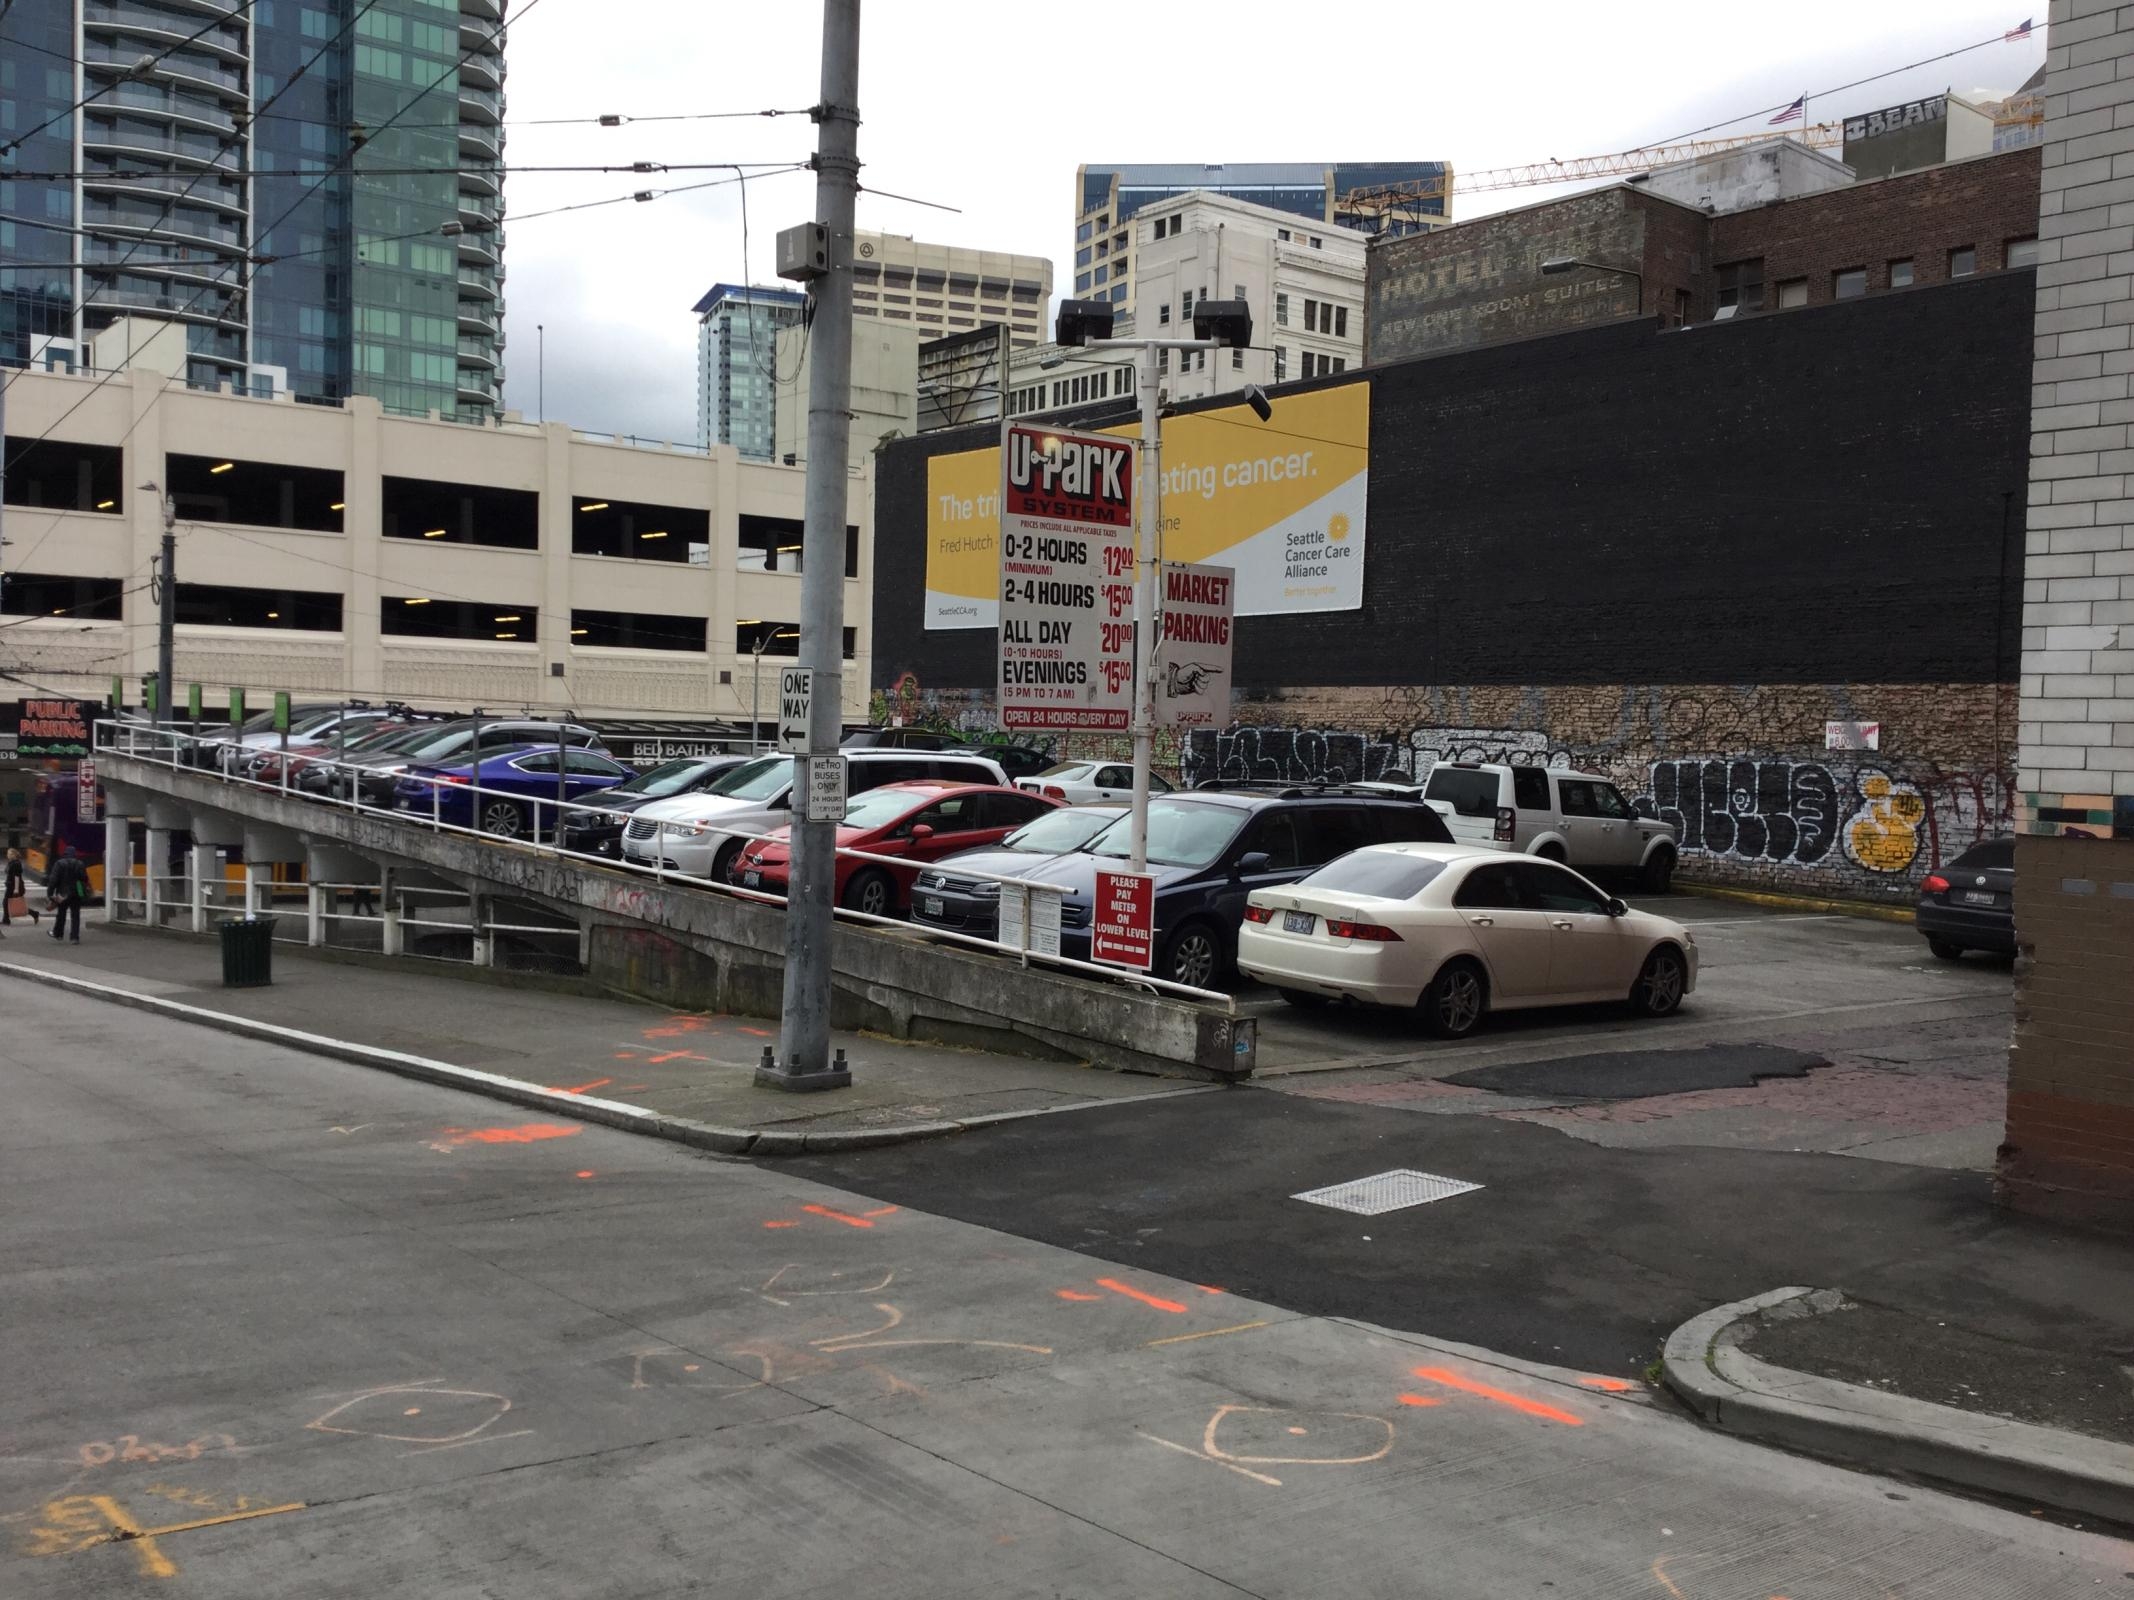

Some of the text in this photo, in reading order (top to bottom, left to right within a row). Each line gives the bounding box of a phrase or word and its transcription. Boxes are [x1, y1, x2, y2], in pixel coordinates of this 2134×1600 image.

[1544, 275, 1622, 303] SUITES
[939, 494, 973, 521] The
[1223, 451, 1317, 488] cancer.
[1023, 498, 1115, 521] SYSTEM
[1020, 520, 1117, 537] PRICES INCLUDE ALL APPLICABLE TAXES
[940, 535, 960, 553] Fred
[963, 534, 993, 551] Hutch
[1286, 530, 1325, 546] Seattle
[1005, 534, 1033, 559] 0-2
[1037, 537, 1087, 565] HOURS
[1285, 545, 1350, 562] Cancer Care
[1284, 564, 1328, 578] Alliance
[1005, 578, 1035, 604] 2-4
[1038, 581, 1095, 609] HOURS
[1167, 572, 1229, 606] MARKET
[1003, 620, 1033, 643] ALL
[1039, 621, 1072, 644] DAY
[1164, 611, 1229, 645] PARKING
[1030, 648, 1063, 660] HOURS)
[1003, 661, 1087, 684] EVENINGS
[784, 674, 810, 694] ONE
[1016, 688, 1031, 698] PM
[1033, 688, 1045, 698] TO
[1049, 689, 1054, 698] 7
[26, 700, 82, 719] PUBLIC
[783, 698, 810, 719] WAY
[1005, 710, 1030, 723] OPEN
[1033, 711, 1045, 723] 24
[1047, 711, 1077, 724] HOURS
[1109, 713, 1127, 726] DAY
[20, 719, 88, 739] PARKING
[633, 743, 720, 757] BED BATH &
[814, 761, 841, 770] METRO
[814, 771, 841, 780] BUSES
[817, 781, 838, 791] ONLY
[821, 795, 843, 803] HOURS
[1110, 875, 1139, 889] PLEASE
[1116, 889, 1132, 900] PAY
[1110, 900, 1137, 913] METER
[1116, 913, 1130, 925] ON
[1096, 922, 1149, 940] LOWER LEVEL
